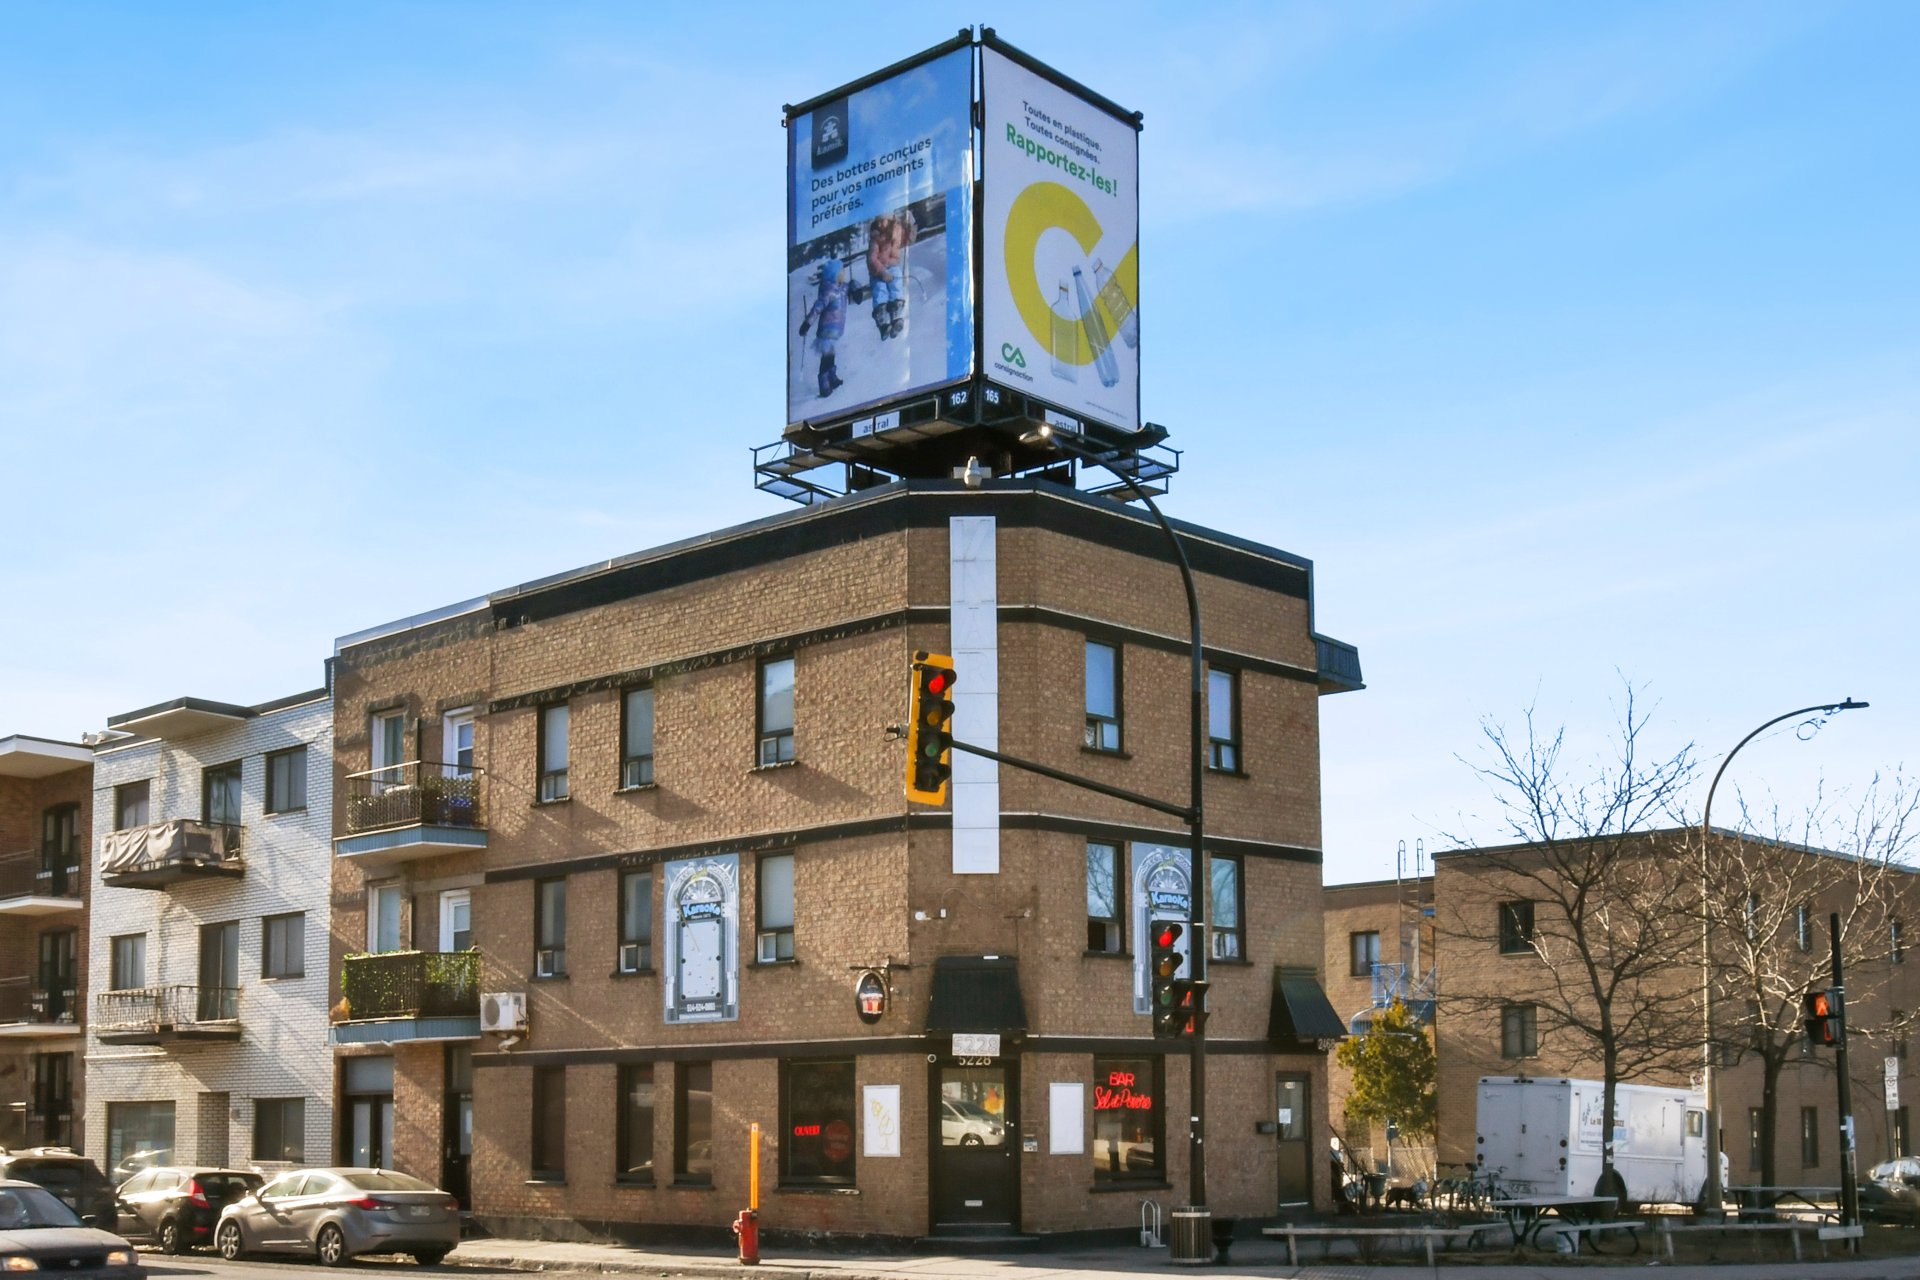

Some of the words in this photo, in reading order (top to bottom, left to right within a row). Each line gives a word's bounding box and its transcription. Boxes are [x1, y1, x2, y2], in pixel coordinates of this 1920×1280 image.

[1023, 100, 1051, 124] Toutes
[1052, 119, 1062, 130] en
[1064, 125, 1101, 151] plastique.
[1025, 116, 1053, 139] Toutes
[1054, 135, 1100, 164] consignées.
[811, 175, 834, 192] Des
[836, 159, 877, 182] bottes
[879, 138, 932, 165] conçues
[1006, 122, 1117, 198] Rapportez-les!
[811, 190, 839, 212] pour
[841, 182, 862, 196] vos
[865, 158, 924, 188] moments
[811, 197, 864, 229] préférés.
[951, 391, 967, 405] 162
[985, 389, 999, 404] 165
[863, 418, 889, 433] asral
[953, 1035, 999, 1055] 5228
[1109, 1071, 1135, 1087] BAR
[1094, 1086, 1112, 1110] Sel
